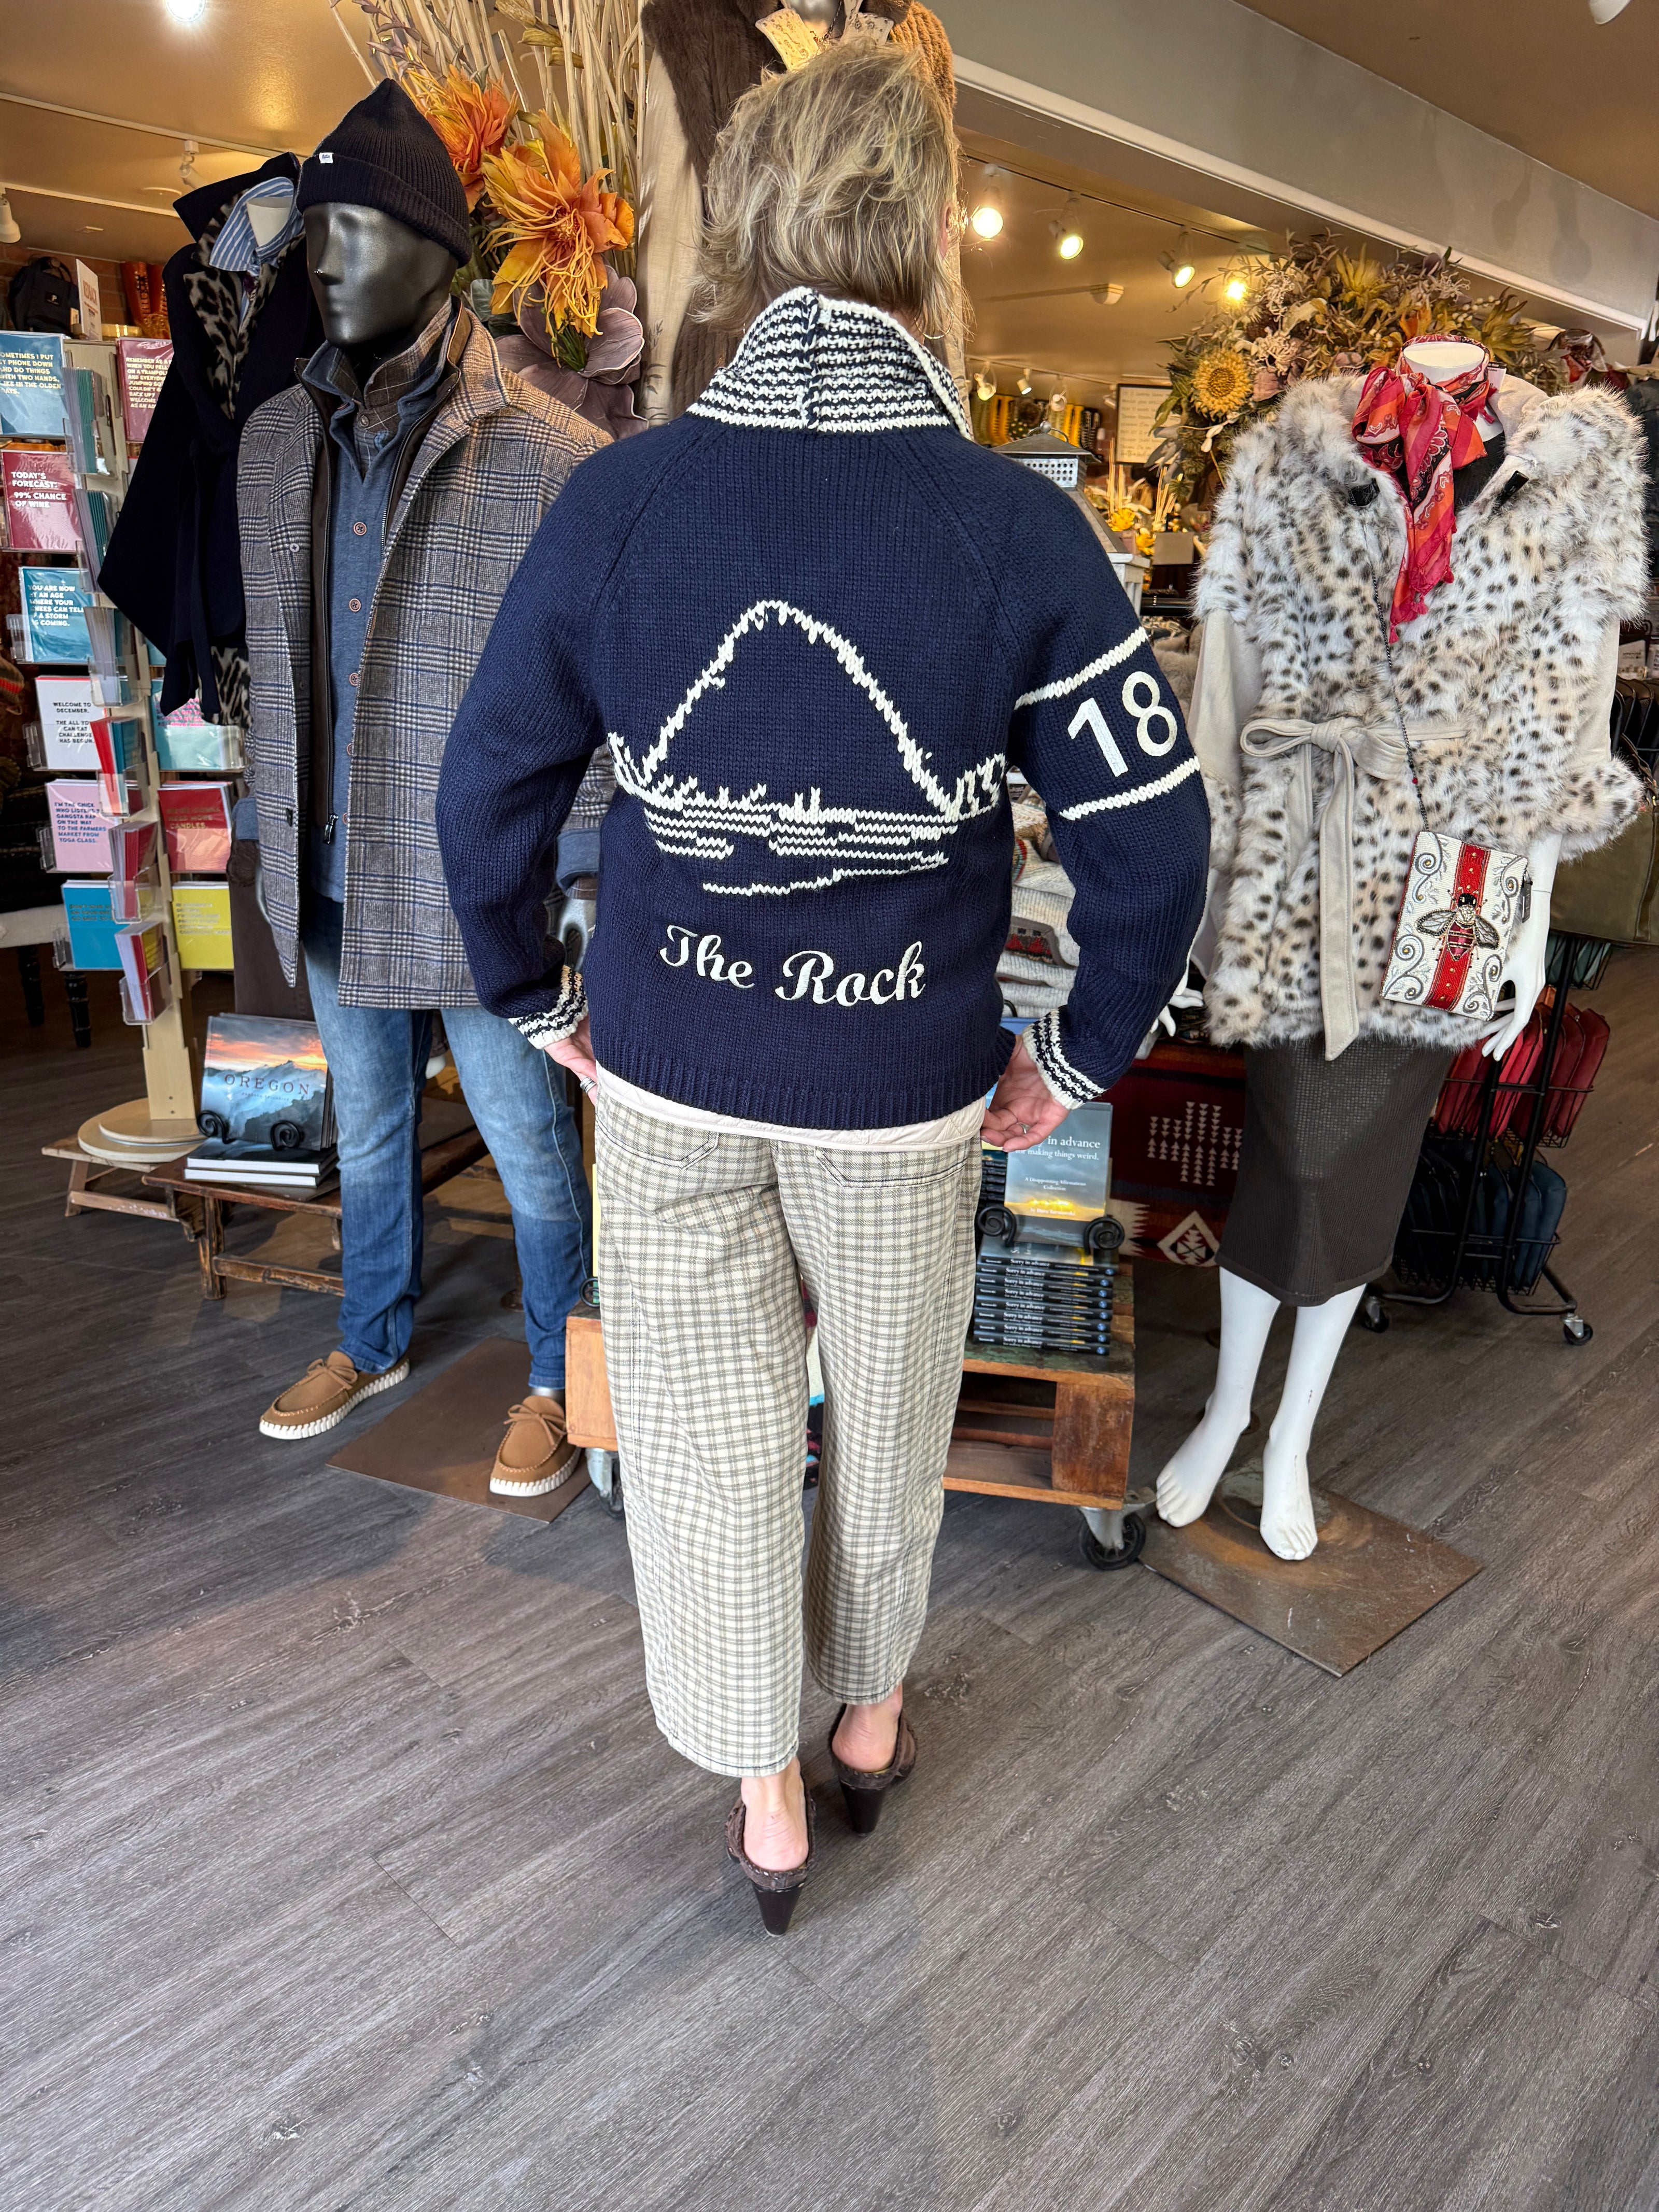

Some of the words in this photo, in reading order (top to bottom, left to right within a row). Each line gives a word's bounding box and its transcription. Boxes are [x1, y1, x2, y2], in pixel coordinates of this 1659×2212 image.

[1067, 671, 1178, 777] 18
[659, 925, 755, 988] The
[775, 941, 926, 1007] Rock
[224, 1074, 309, 1095] OREGON
[1047, 1136, 1057, 1145] in
[1060, 1136, 1101, 1149] advance
[1028, 1148, 1053, 1159] making
[1055, 1149, 1075, 1161] things
